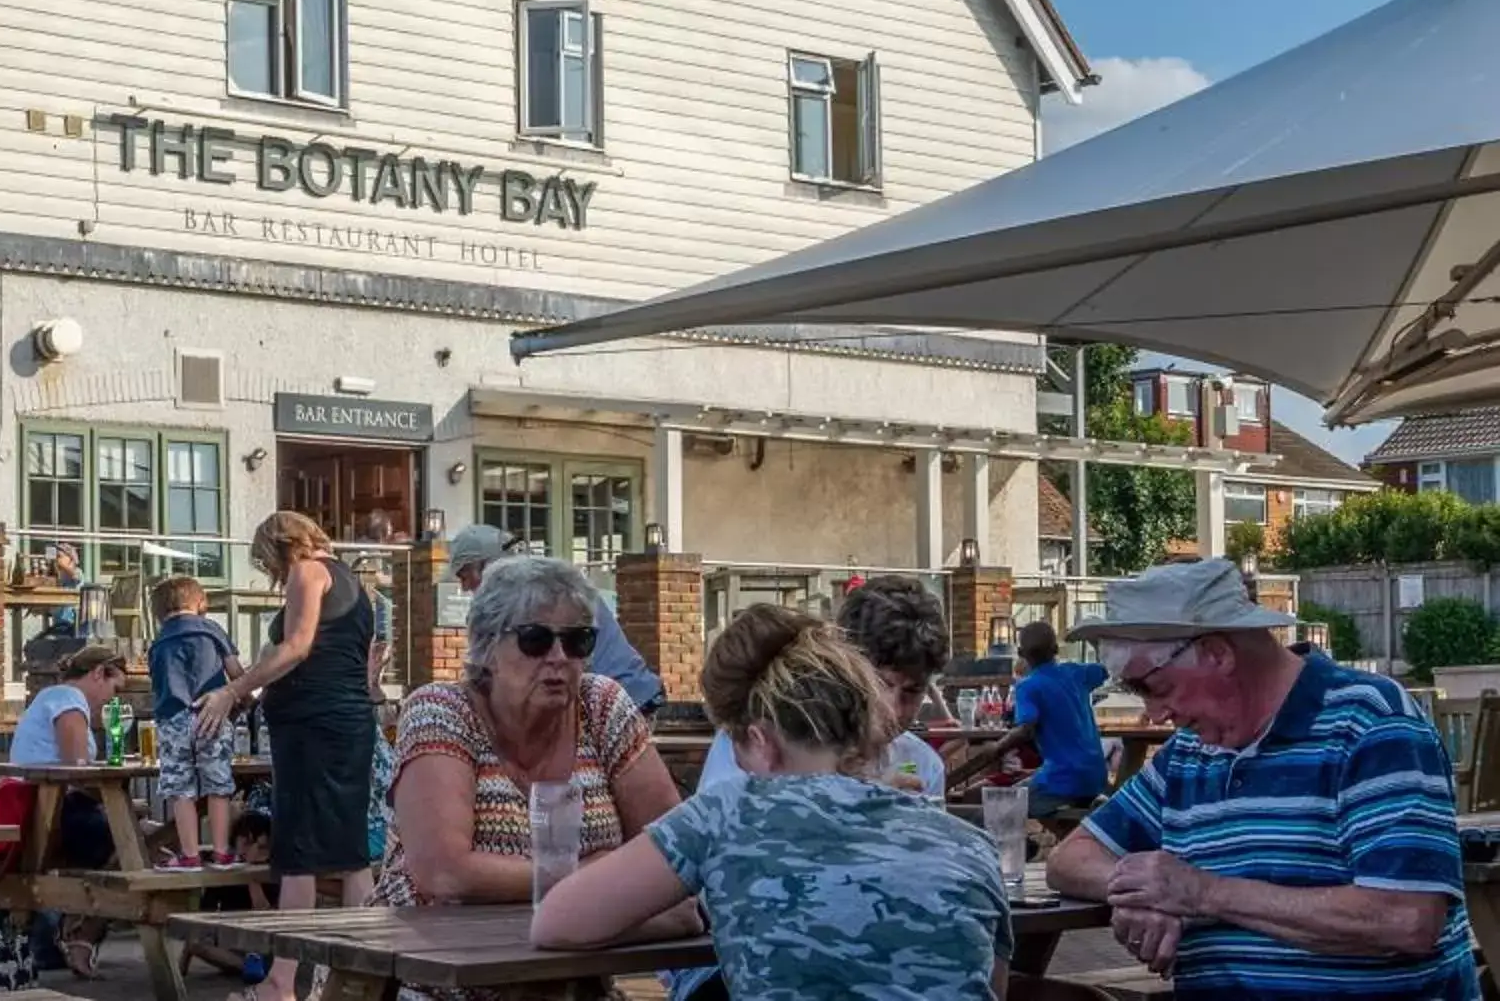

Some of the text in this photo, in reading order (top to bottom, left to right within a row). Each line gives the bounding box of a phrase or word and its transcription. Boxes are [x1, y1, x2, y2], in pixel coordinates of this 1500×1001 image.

[110, 113, 598, 230] THE BOTANY BAY
[184, 208, 543, 270] BAR RESTAURANT HOTEL
[295, 404, 419, 430] BAR ENTRANCE
